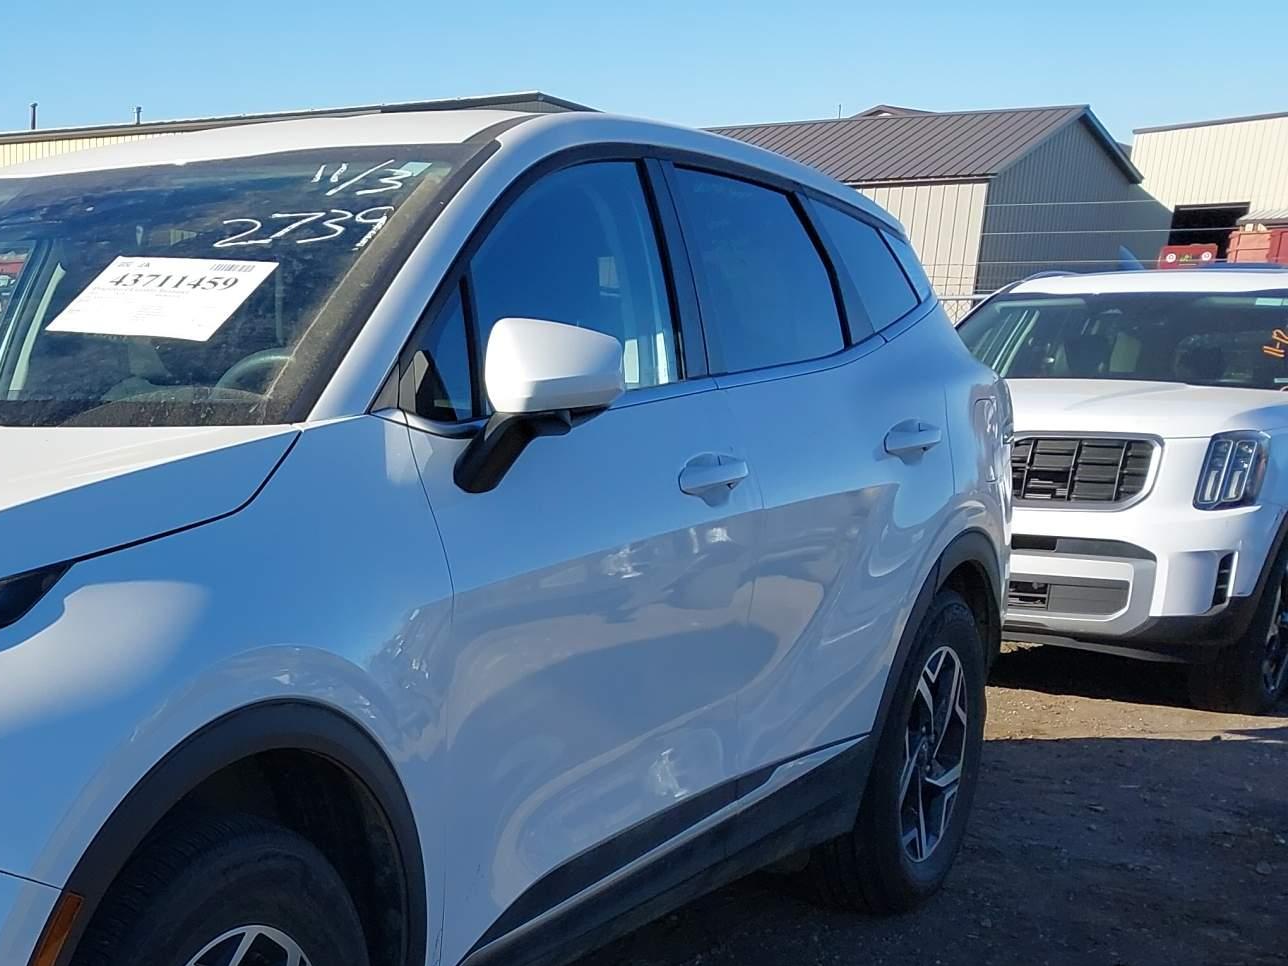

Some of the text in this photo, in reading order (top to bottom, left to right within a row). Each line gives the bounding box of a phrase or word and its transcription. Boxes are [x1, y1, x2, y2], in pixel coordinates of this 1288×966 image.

[312, 159, 412, 196] 11/3
[213, 206, 395, 250] 2739
[109, 272, 239, 291] 43711459
